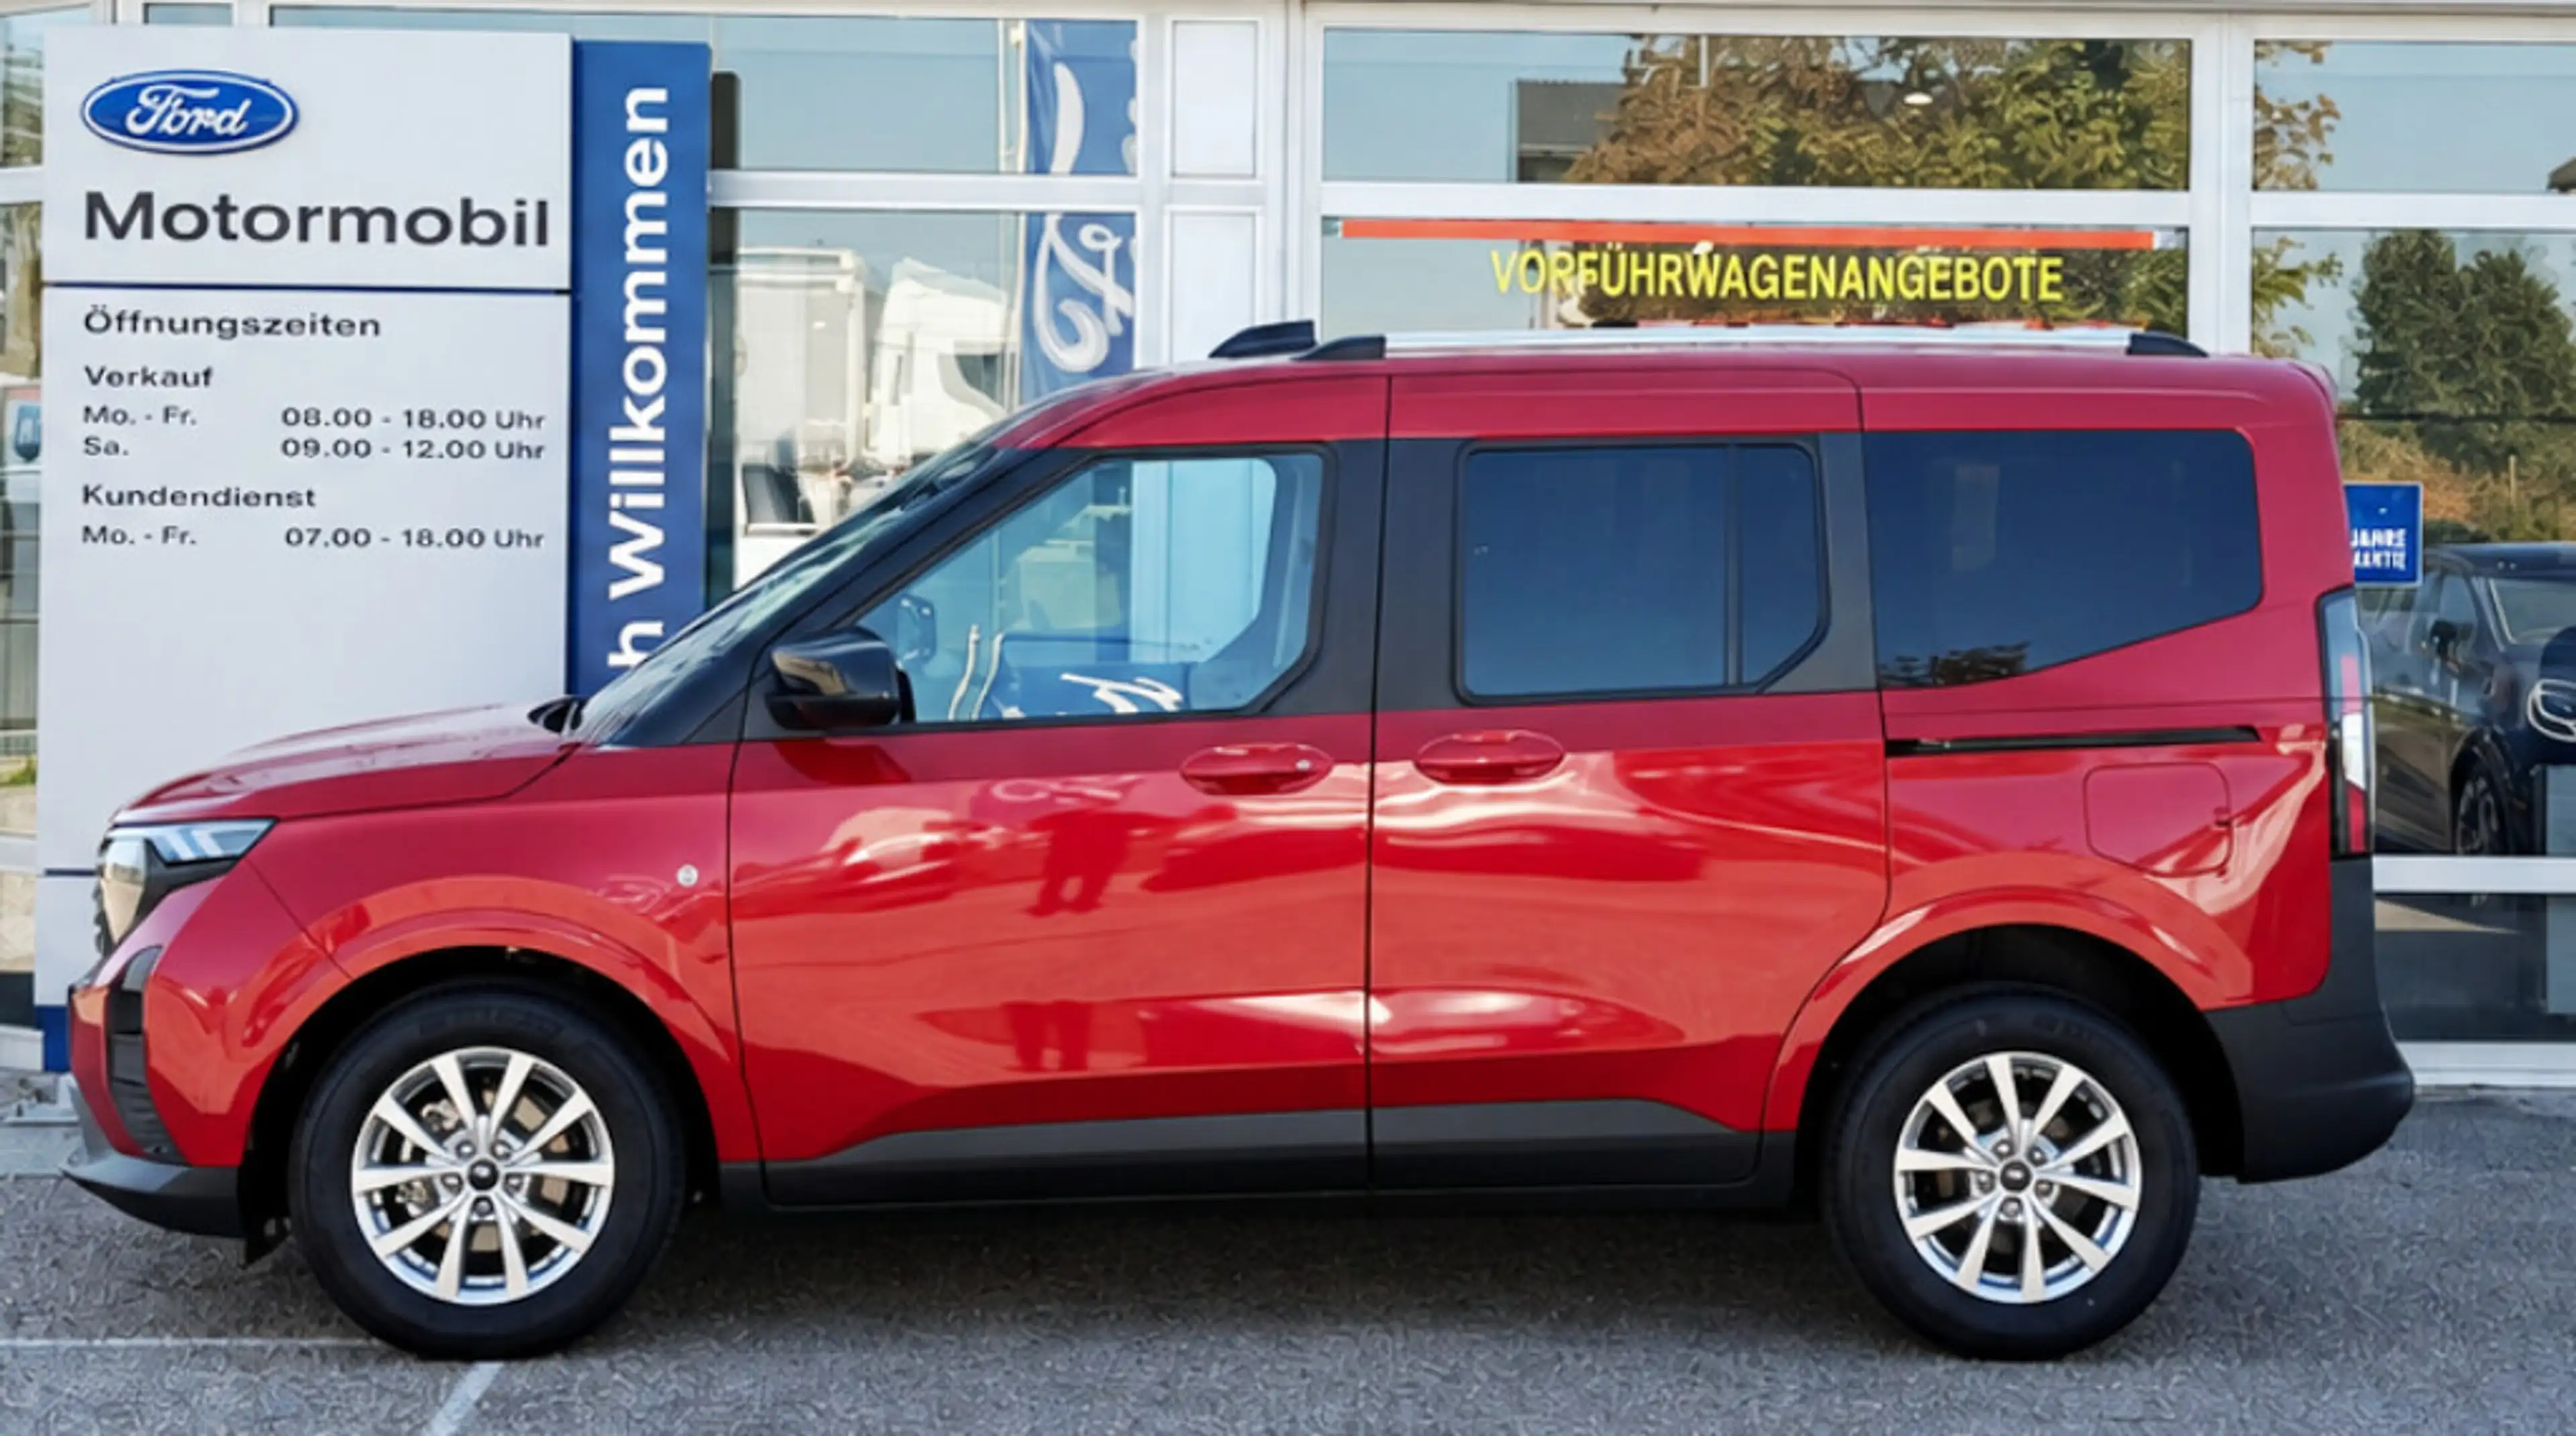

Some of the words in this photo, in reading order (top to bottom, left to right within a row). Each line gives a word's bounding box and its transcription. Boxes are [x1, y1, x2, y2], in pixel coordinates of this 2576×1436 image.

[125, 84, 252, 135] Ford
[85, 190, 549, 247] Motormobil
[1491, 244, 2064, 301] VORFÜHRWAGENANGEBOTE
[83, 304, 381, 341] Öffnungszeiten
[608, 87, 668, 600] Willkommen
[84, 365, 214, 388] Verkauf
[83, 404, 137, 426] Mo.
[162, 405, 197, 425] Fr.
[280, 406, 372, 428] 08.00
[402, 408, 487, 430] 18.00
[495, 410, 545, 431] Uhr
[83, 435, 129, 456] Sa.
[280, 437, 372, 459] 09.00
[402, 439, 486, 459] 12.00
[494, 441, 545, 459] Uhr
[82, 484, 317, 508] Kundendienst
[81, 524, 136, 545] Mo.
[161, 525, 197, 545] Fr.
[284, 527, 372, 548] 07.00
[402, 528, 486, 549] 18.00
[493, 529, 545, 549] Uhr
